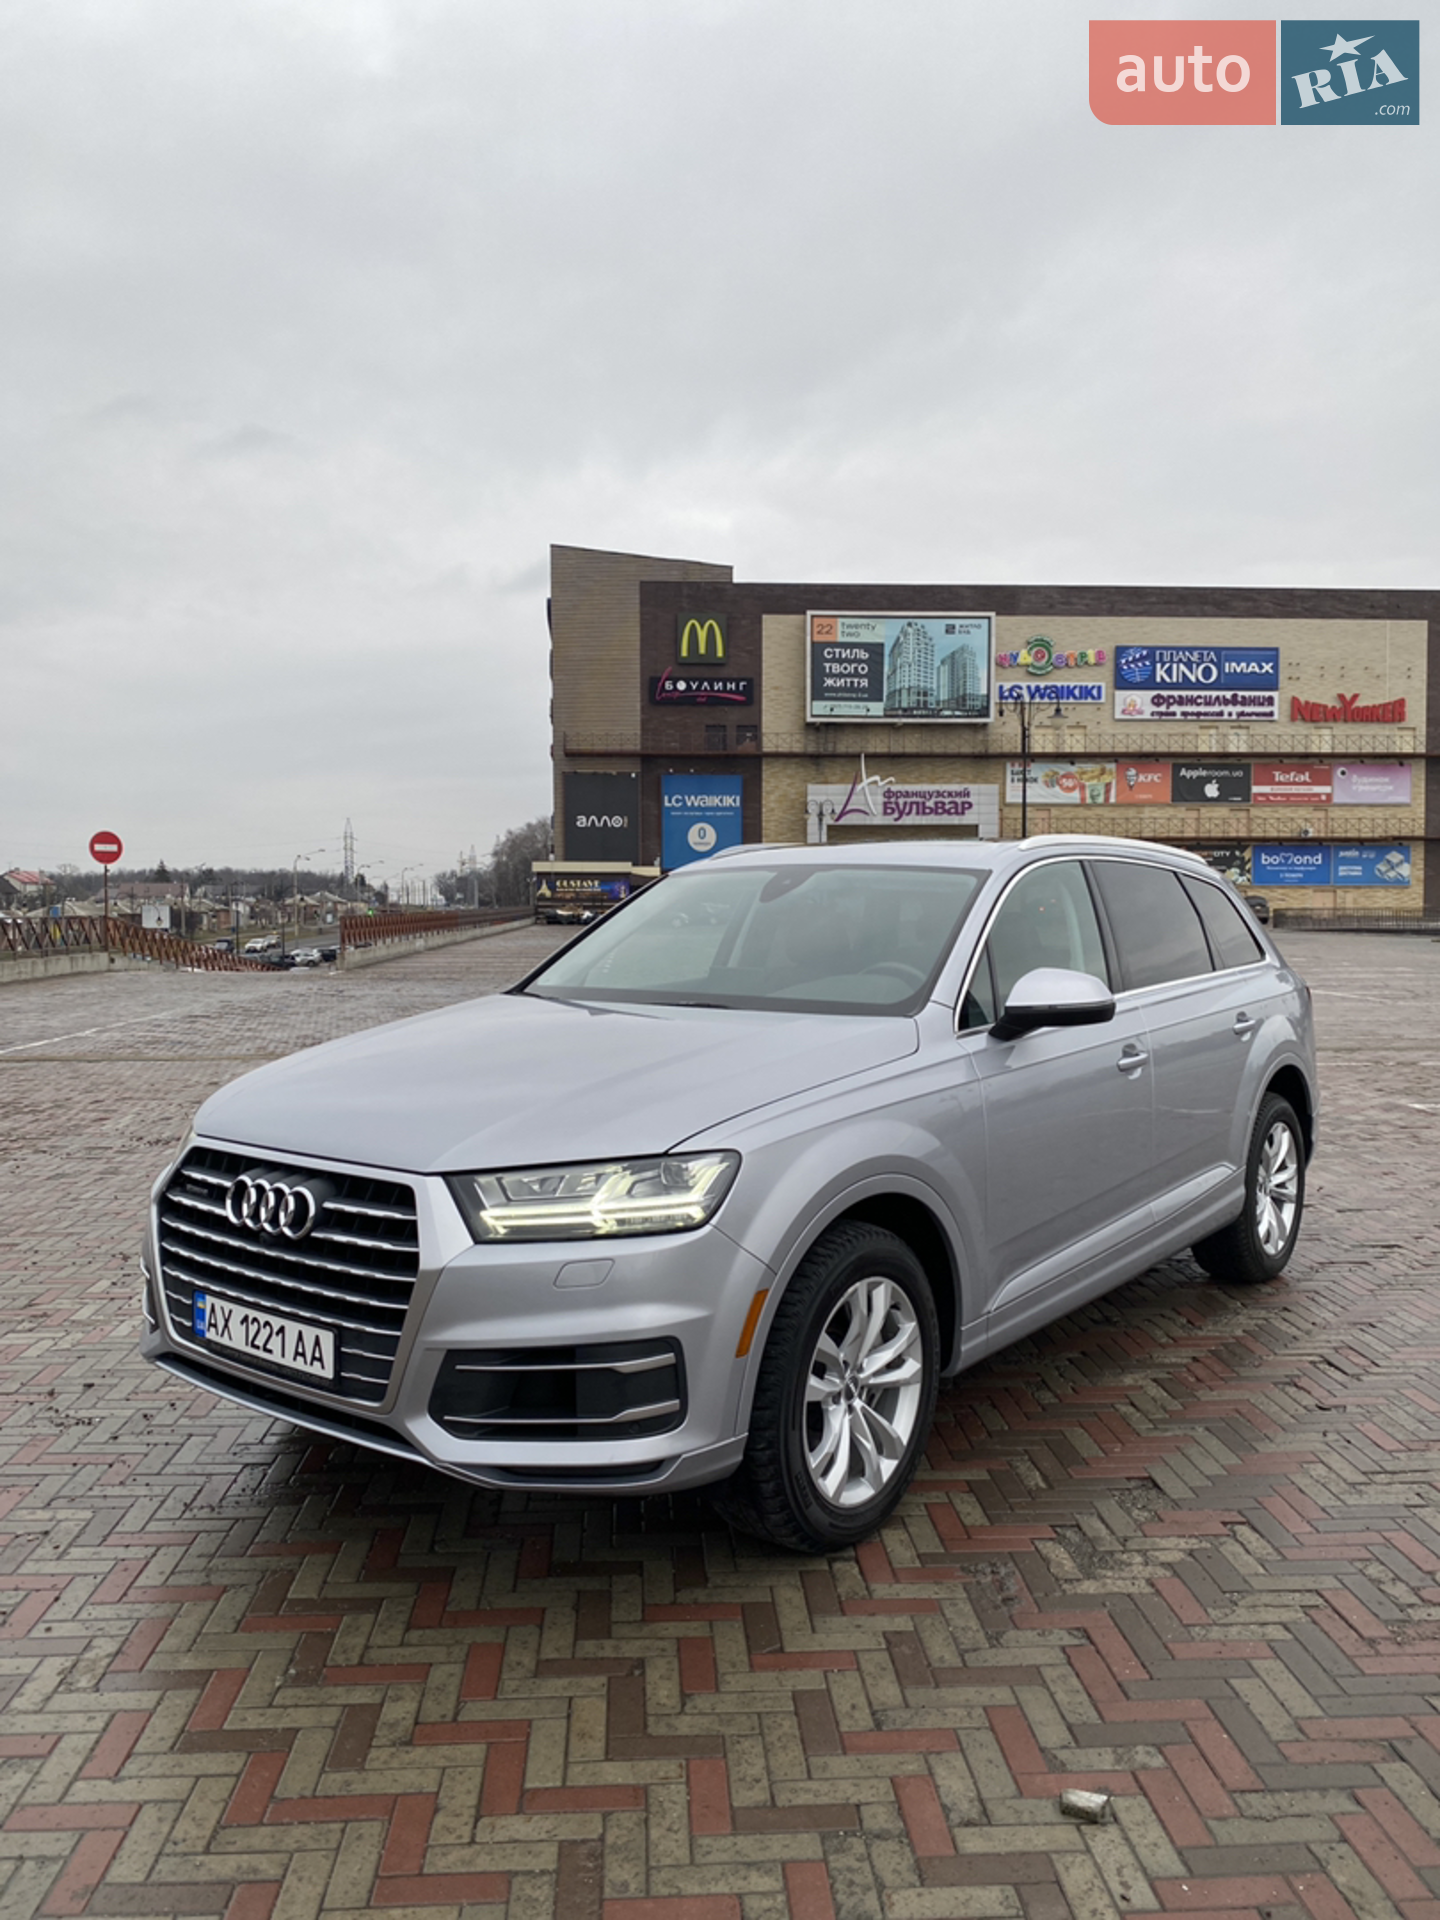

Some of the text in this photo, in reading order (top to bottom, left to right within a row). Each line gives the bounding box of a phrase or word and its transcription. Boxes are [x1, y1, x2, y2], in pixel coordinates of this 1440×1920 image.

[816, 624, 833, 635] 22
[841, 622, 876, 632] twenty
[823, 648, 869, 660] СТИЛЬ
[823, 662, 869, 675] ТВОГО
[1155, 662, 1218, 684] KINO
[1224, 662, 1274, 674] IMAX
[664, 680, 747, 691] БОУЛИНГ
[823, 677, 869, 688] ЖИТТЯ
[1151, 693, 1275, 709] Франсильвания
[1138, 773, 1162, 783] KFC
[1179, 767, 1243, 779] Appleroom.ua
[1272, 771, 1312, 783] Tefal
[882, 787, 971, 802] французский
[664, 795, 683, 807] LC
[207, 1303, 325, 1370] AX 1221 AA
